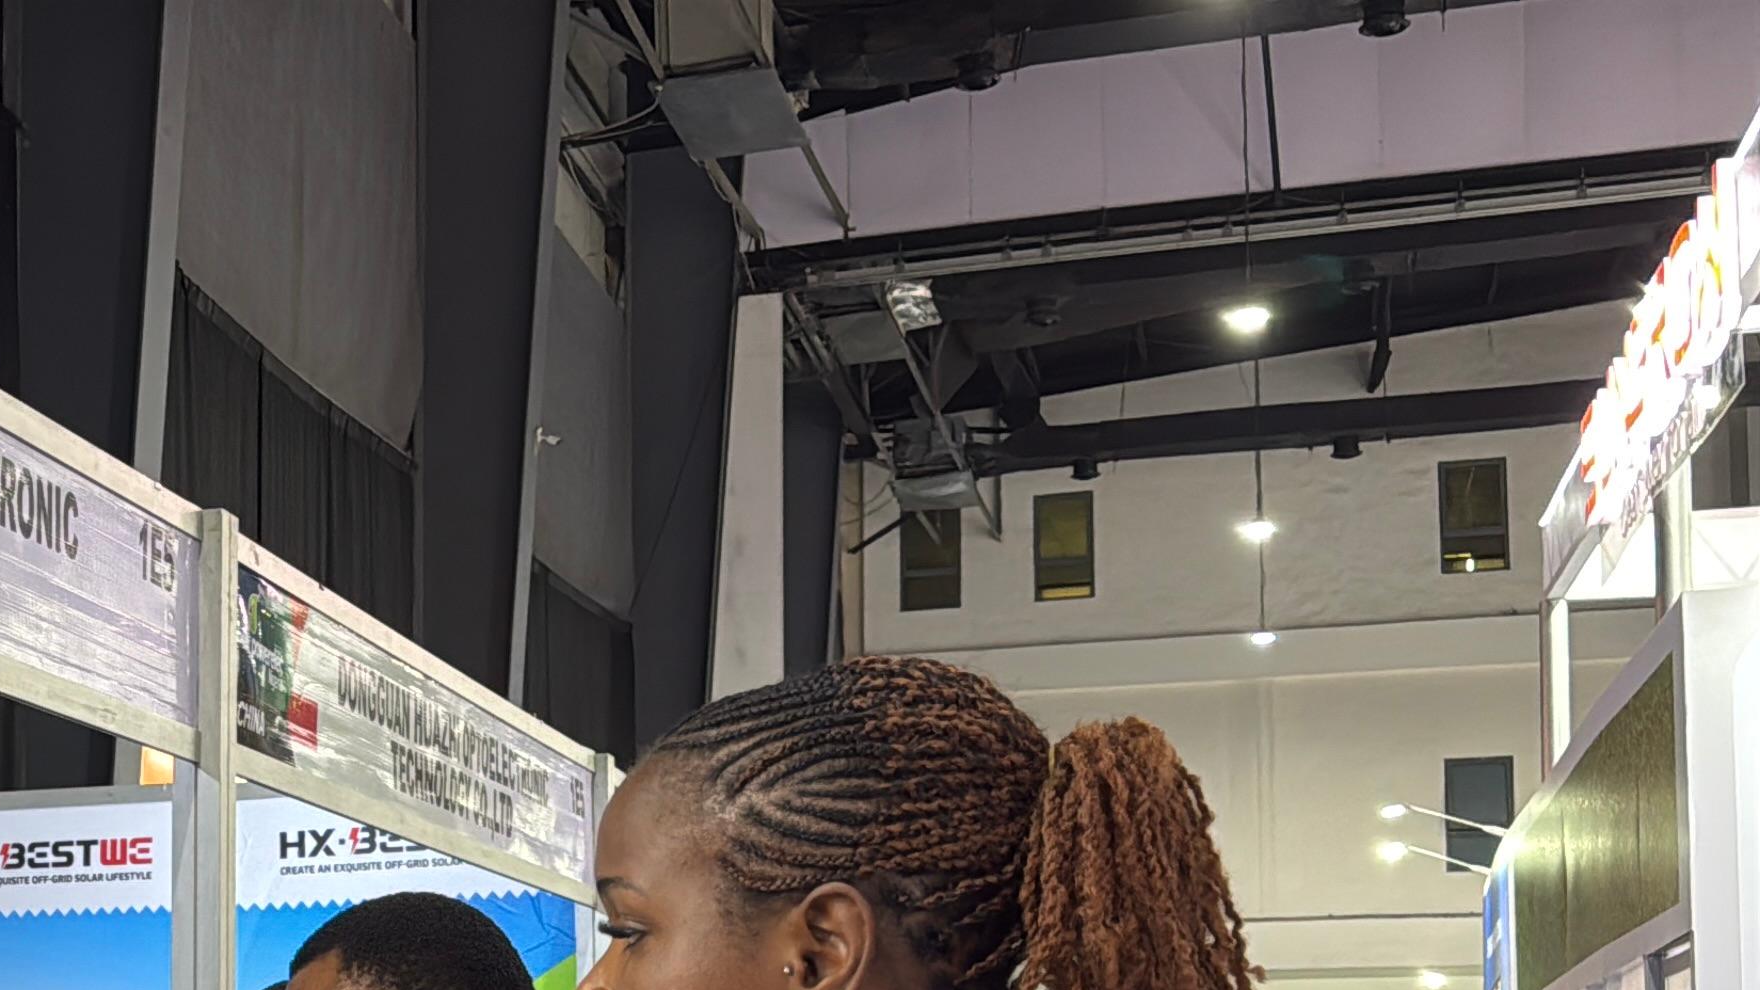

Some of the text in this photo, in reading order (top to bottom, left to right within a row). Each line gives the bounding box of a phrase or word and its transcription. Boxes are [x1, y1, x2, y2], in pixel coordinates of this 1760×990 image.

[280, 865, 315, 875] CREATE
[317, 864, 331, 873] AN
[334, 861, 382, 873] EXQUISITE
[385, 859, 429, 869] OFF-GRID
[31, 874, 73, 885] OFF-GRID
[74, 873, 104, 883] SOLAR
[105, 871, 152, 882] LIFESTYLE
